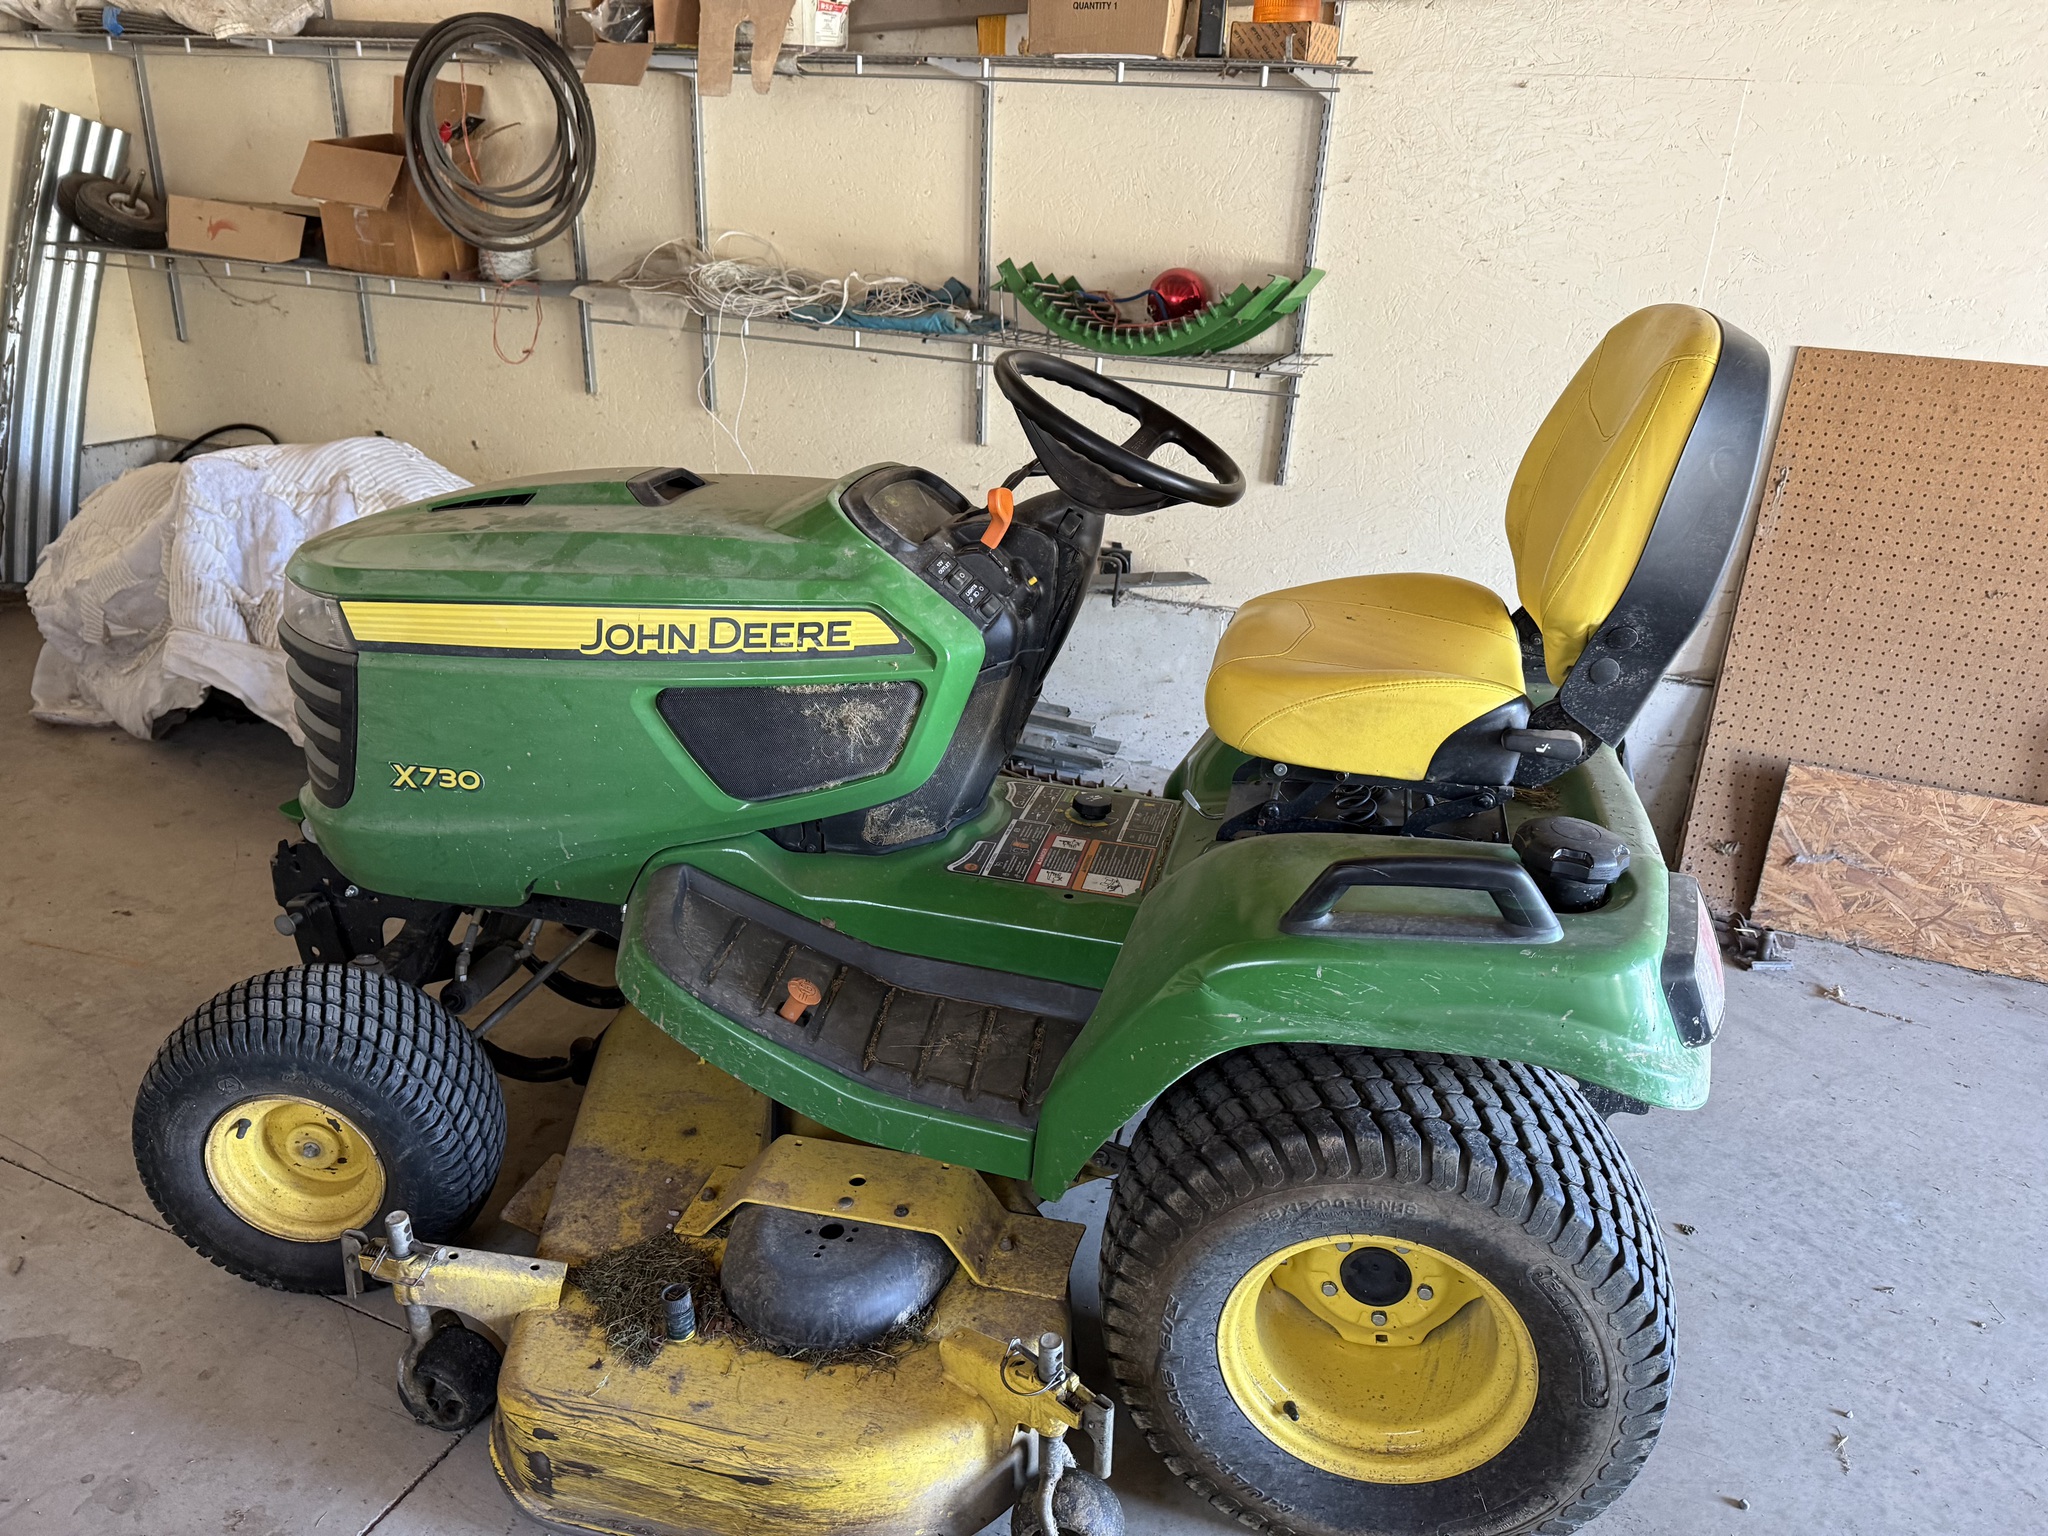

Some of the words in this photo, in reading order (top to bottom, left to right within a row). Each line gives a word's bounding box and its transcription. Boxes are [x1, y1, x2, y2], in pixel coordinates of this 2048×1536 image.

[1072, 1, 1111, 10] QUANTITY
[1114, 1, 1118, 10] 1
[938, 561, 951, 574] OUTLET
[580, 618, 698, 652] JOHN
[708, 617, 853, 651] DEERE
[391, 763, 482, 791] X730
